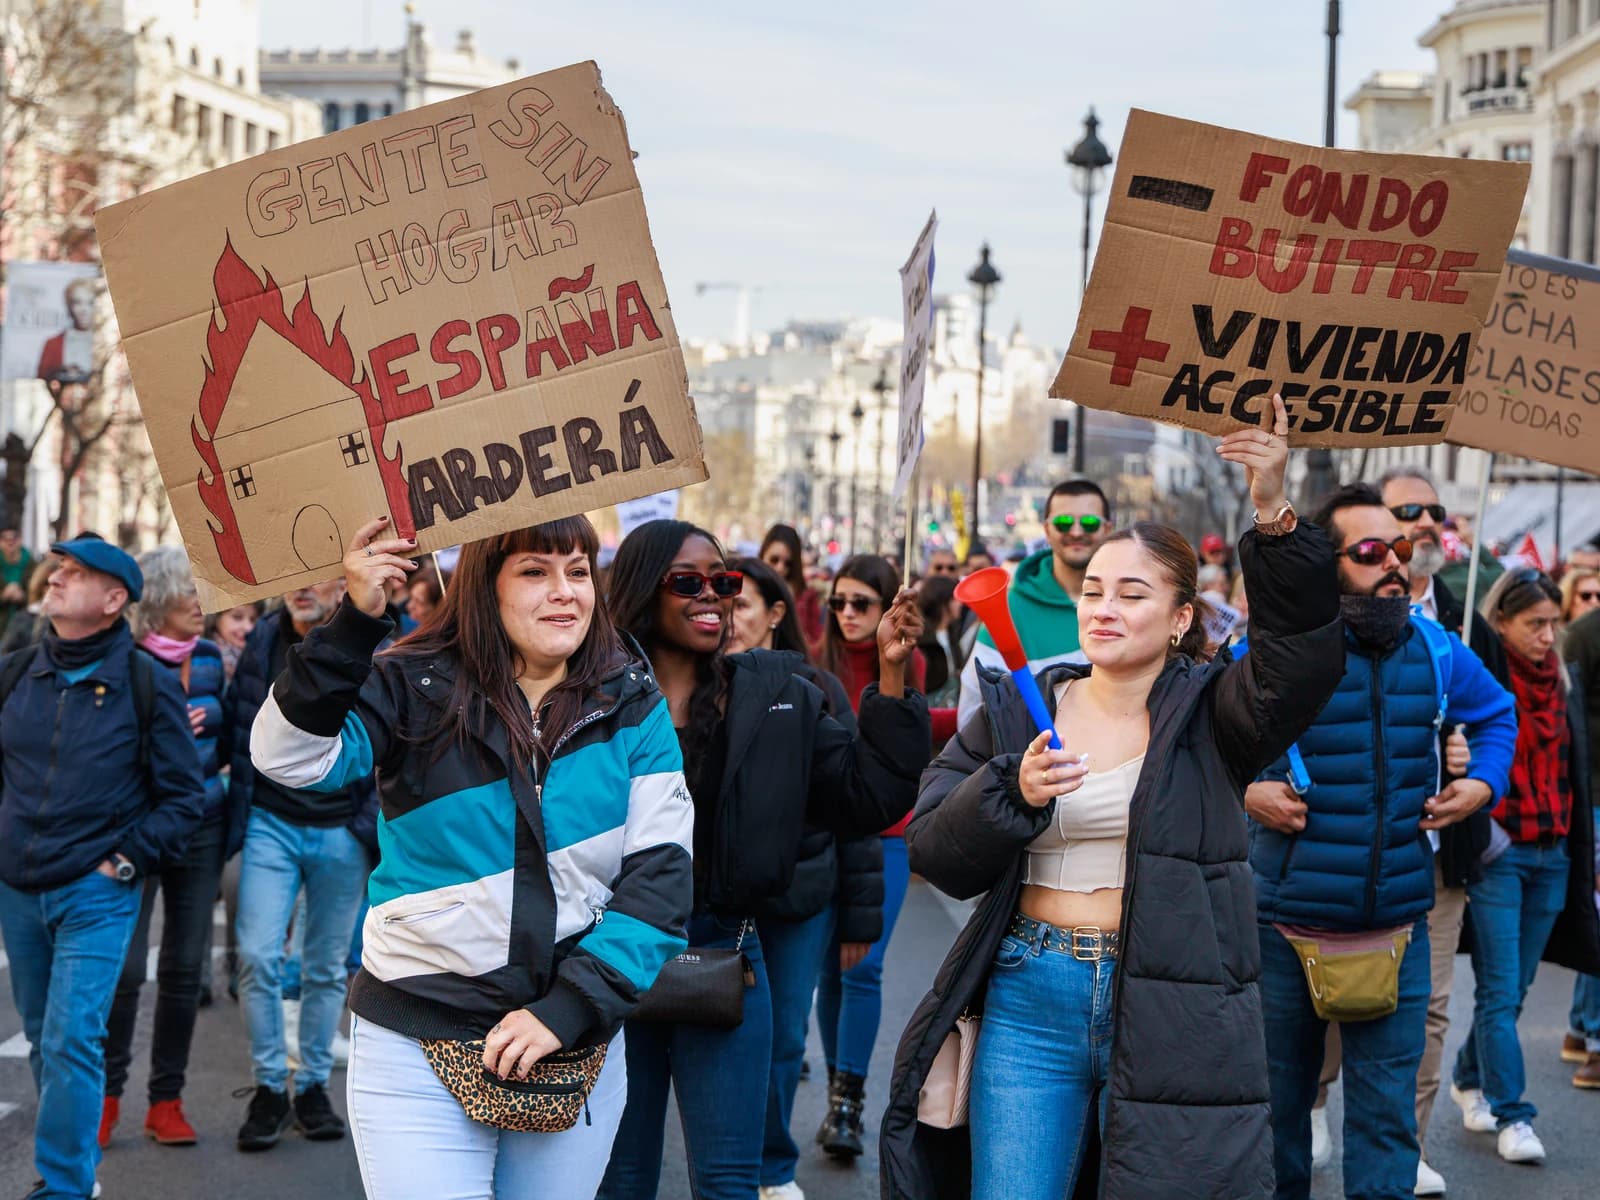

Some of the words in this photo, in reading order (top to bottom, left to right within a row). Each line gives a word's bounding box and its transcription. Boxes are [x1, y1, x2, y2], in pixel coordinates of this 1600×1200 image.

[246, 113, 486, 238] GENTE
[488, 86, 612, 206] SIN
[1239, 151, 1449, 237] FONDO
[355, 192, 578, 305] HOGAR
[1208, 217, 1479, 304] BUITRE
[1545, 273, 1579, 301] ES
[368, 264, 664, 417] ESPAÑA
[1191, 303, 1472, 385] VIVIENDA
[1160, 363, 1452, 436] ACCESIBLE
[1498, 396, 1582, 438] TODAS
[404, 379, 675, 532] ARDERÁ
